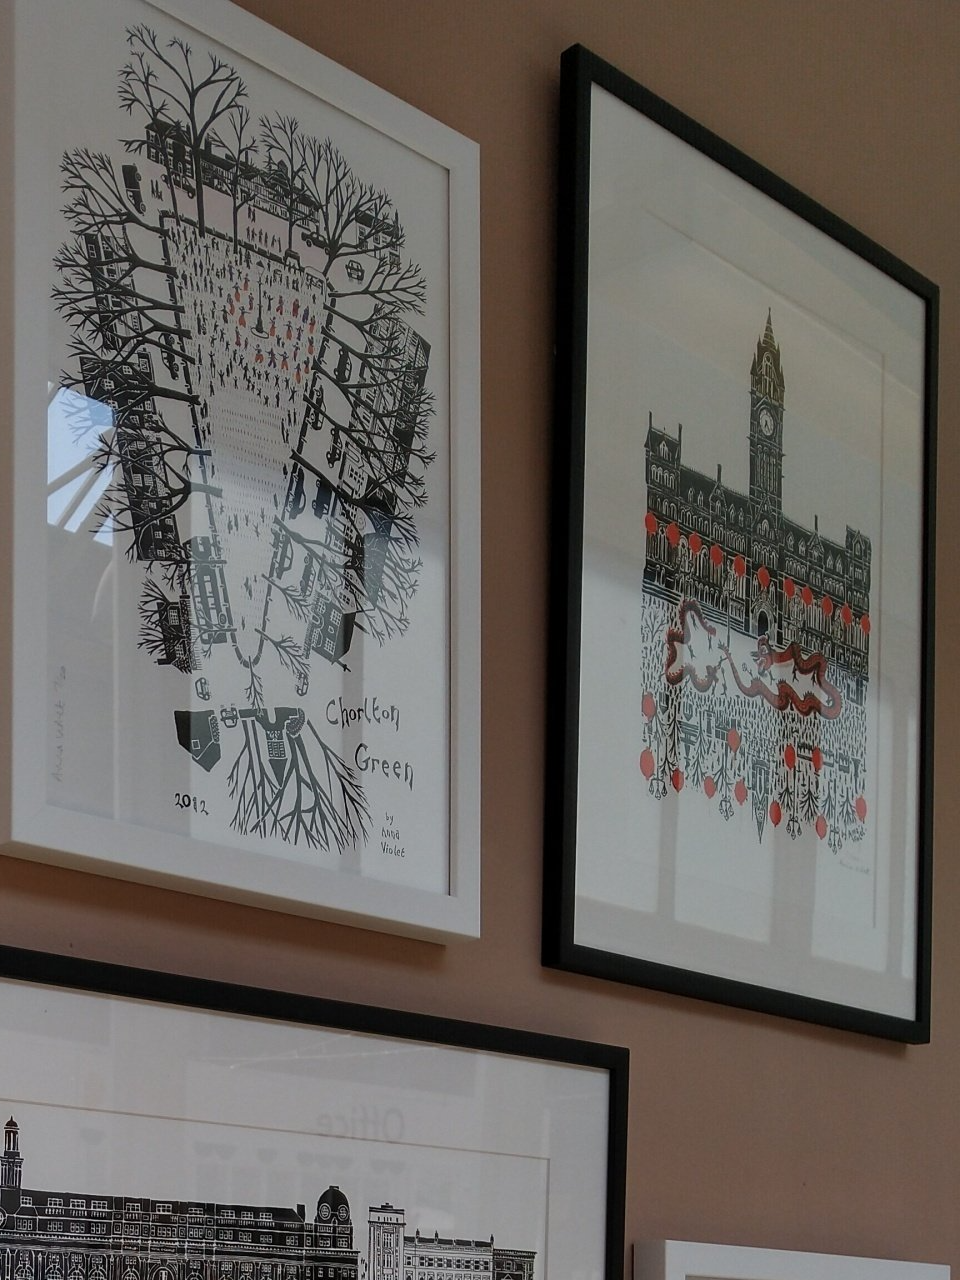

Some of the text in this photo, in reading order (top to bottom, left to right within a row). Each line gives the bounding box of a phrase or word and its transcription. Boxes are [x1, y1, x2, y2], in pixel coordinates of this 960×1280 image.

[326, 696, 400, 732] Chorlton
[354, 743, 414, 791] Green
[175, 793, 209, 815] 2012
[385, 811, 394, 826] by
[381, 827, 400, 840] Anna
[381, 841, 405, 858] Violet
